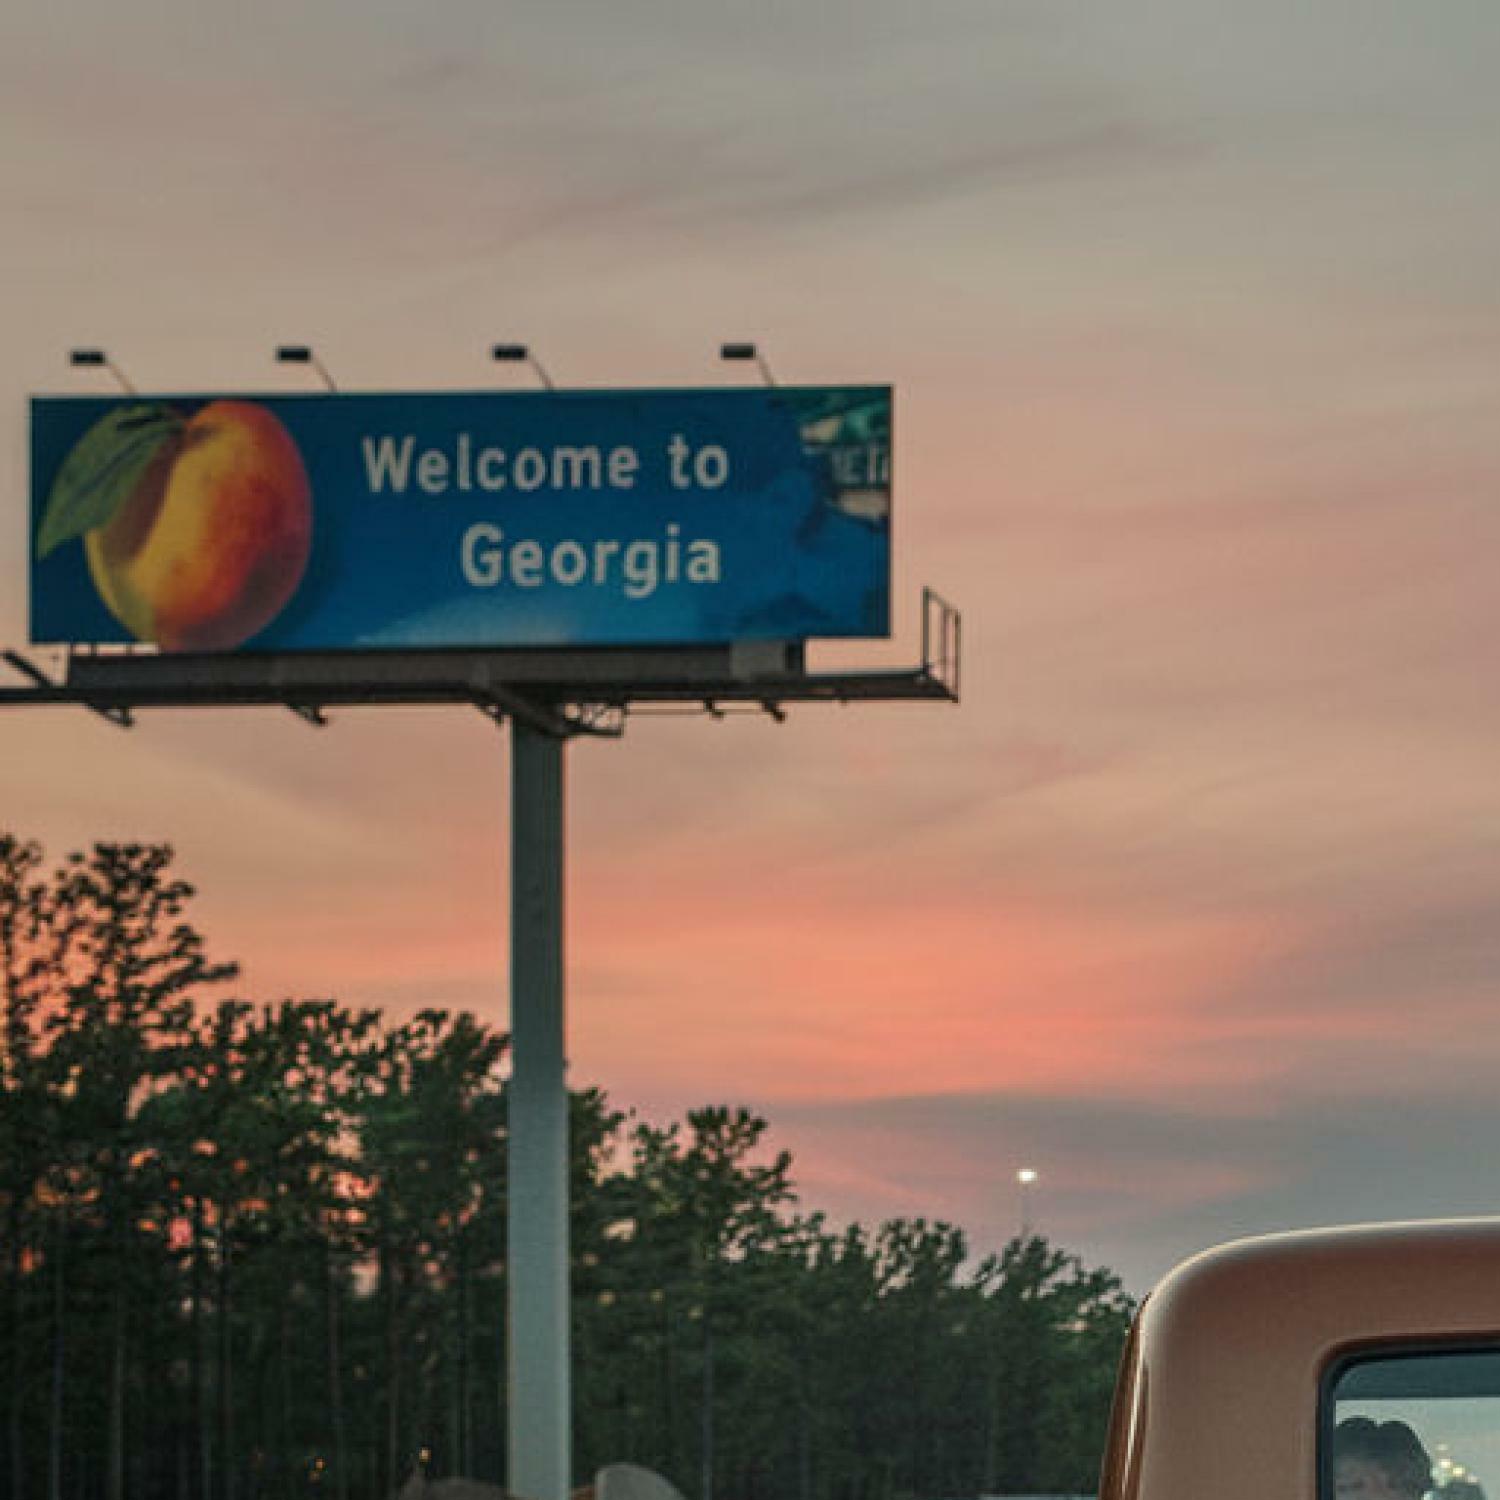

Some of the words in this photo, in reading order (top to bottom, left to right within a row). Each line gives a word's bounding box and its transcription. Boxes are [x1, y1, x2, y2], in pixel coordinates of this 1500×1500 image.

[361, 433, 641, 493] Welcome
[668, 434, 730, 490] to
[460, 523, 722, 598] Georgia
